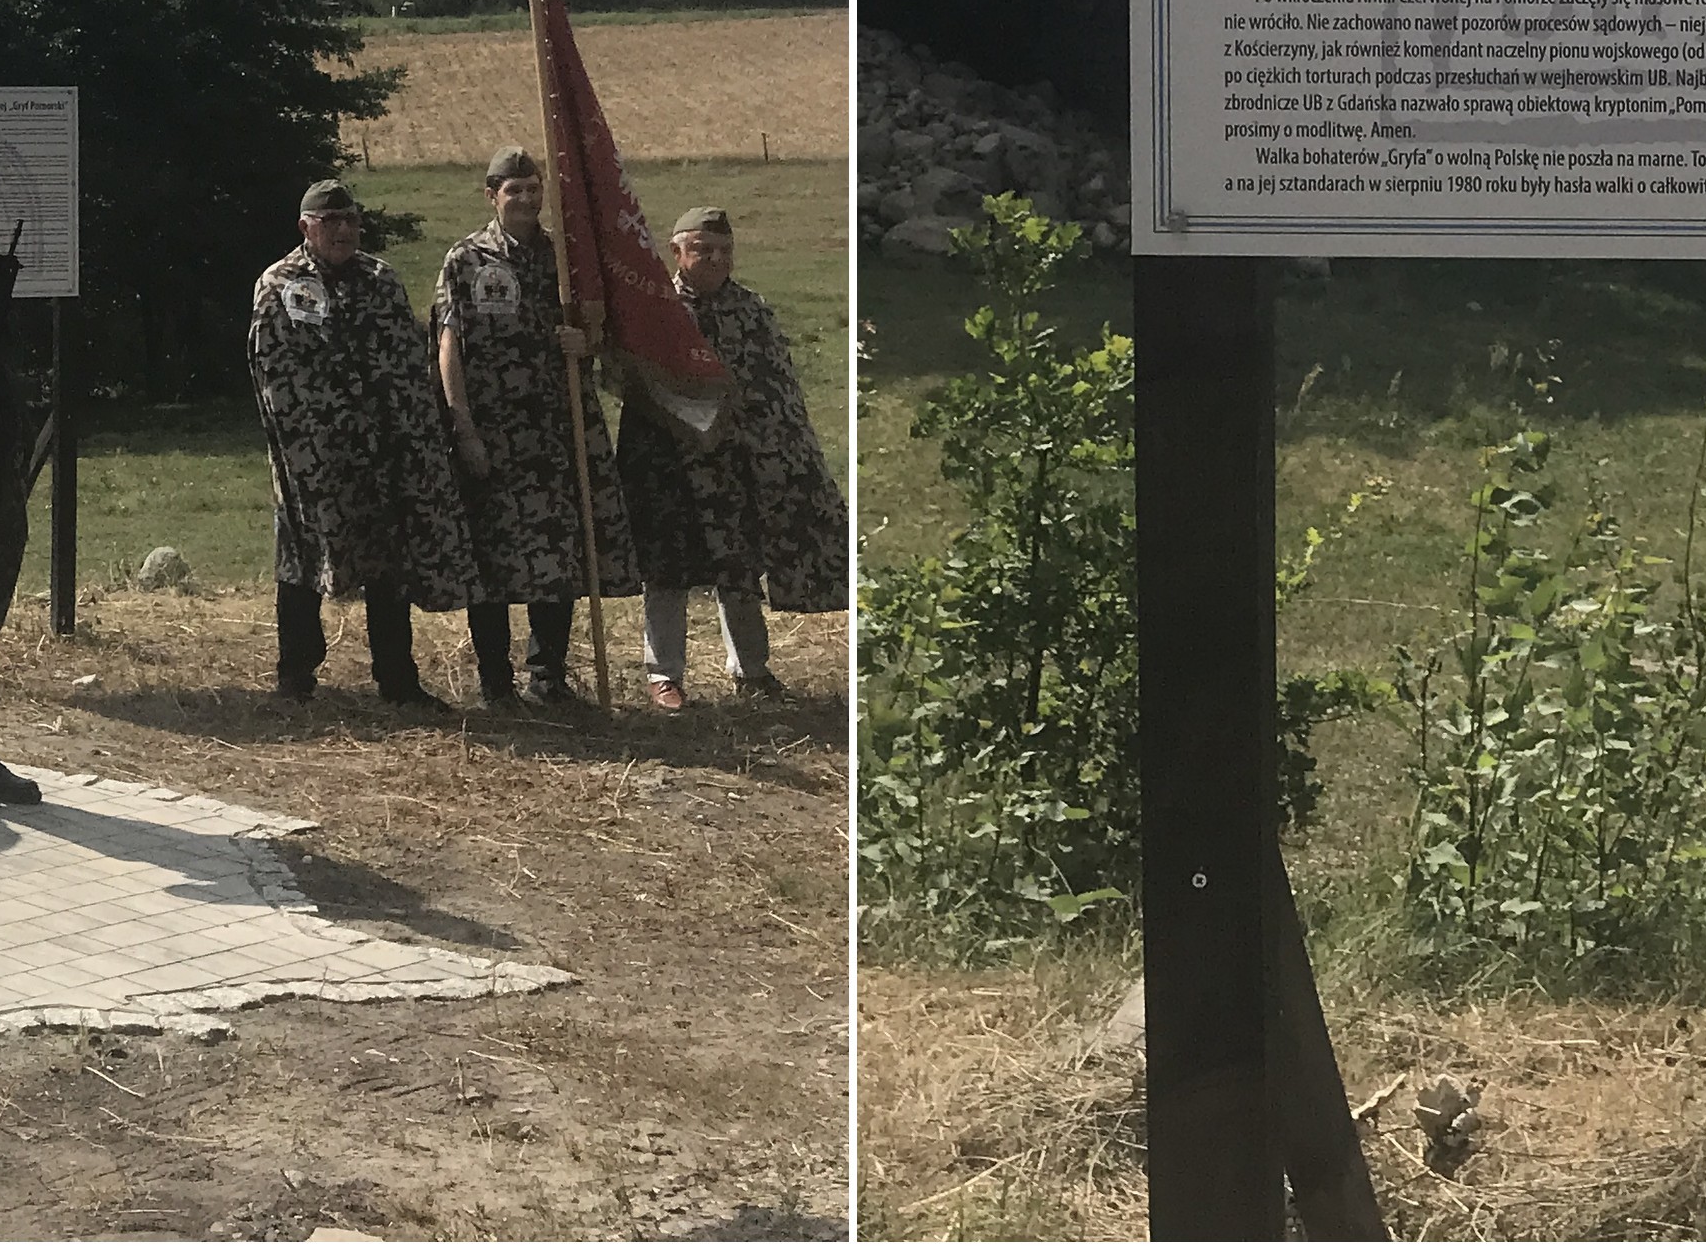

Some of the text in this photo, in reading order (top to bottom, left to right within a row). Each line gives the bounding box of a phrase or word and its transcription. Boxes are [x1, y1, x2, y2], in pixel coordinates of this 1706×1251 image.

[1224, 120, 1416, 142] prosimy o modlitwę. Amen.
[1224, 177, 1233, 191] a
[1236, 177, 1254, 191] na
[1256, 174, 1276, 195] jej
[1278, 173, 1365, 192] sztandarach
[1368, 178, 1382, 192] w
[1384, 175, 1442, 196] sierpniu
[1446, 175, 1482, 193] 1980
[1485, 174, 1517, 193] roku
[1520, 174, 1551, 197] były
[1554, 175, 1592, 193] hasła
[1594, 175, 1634, 194] walki
[1636, 180, 1646, 194] o
